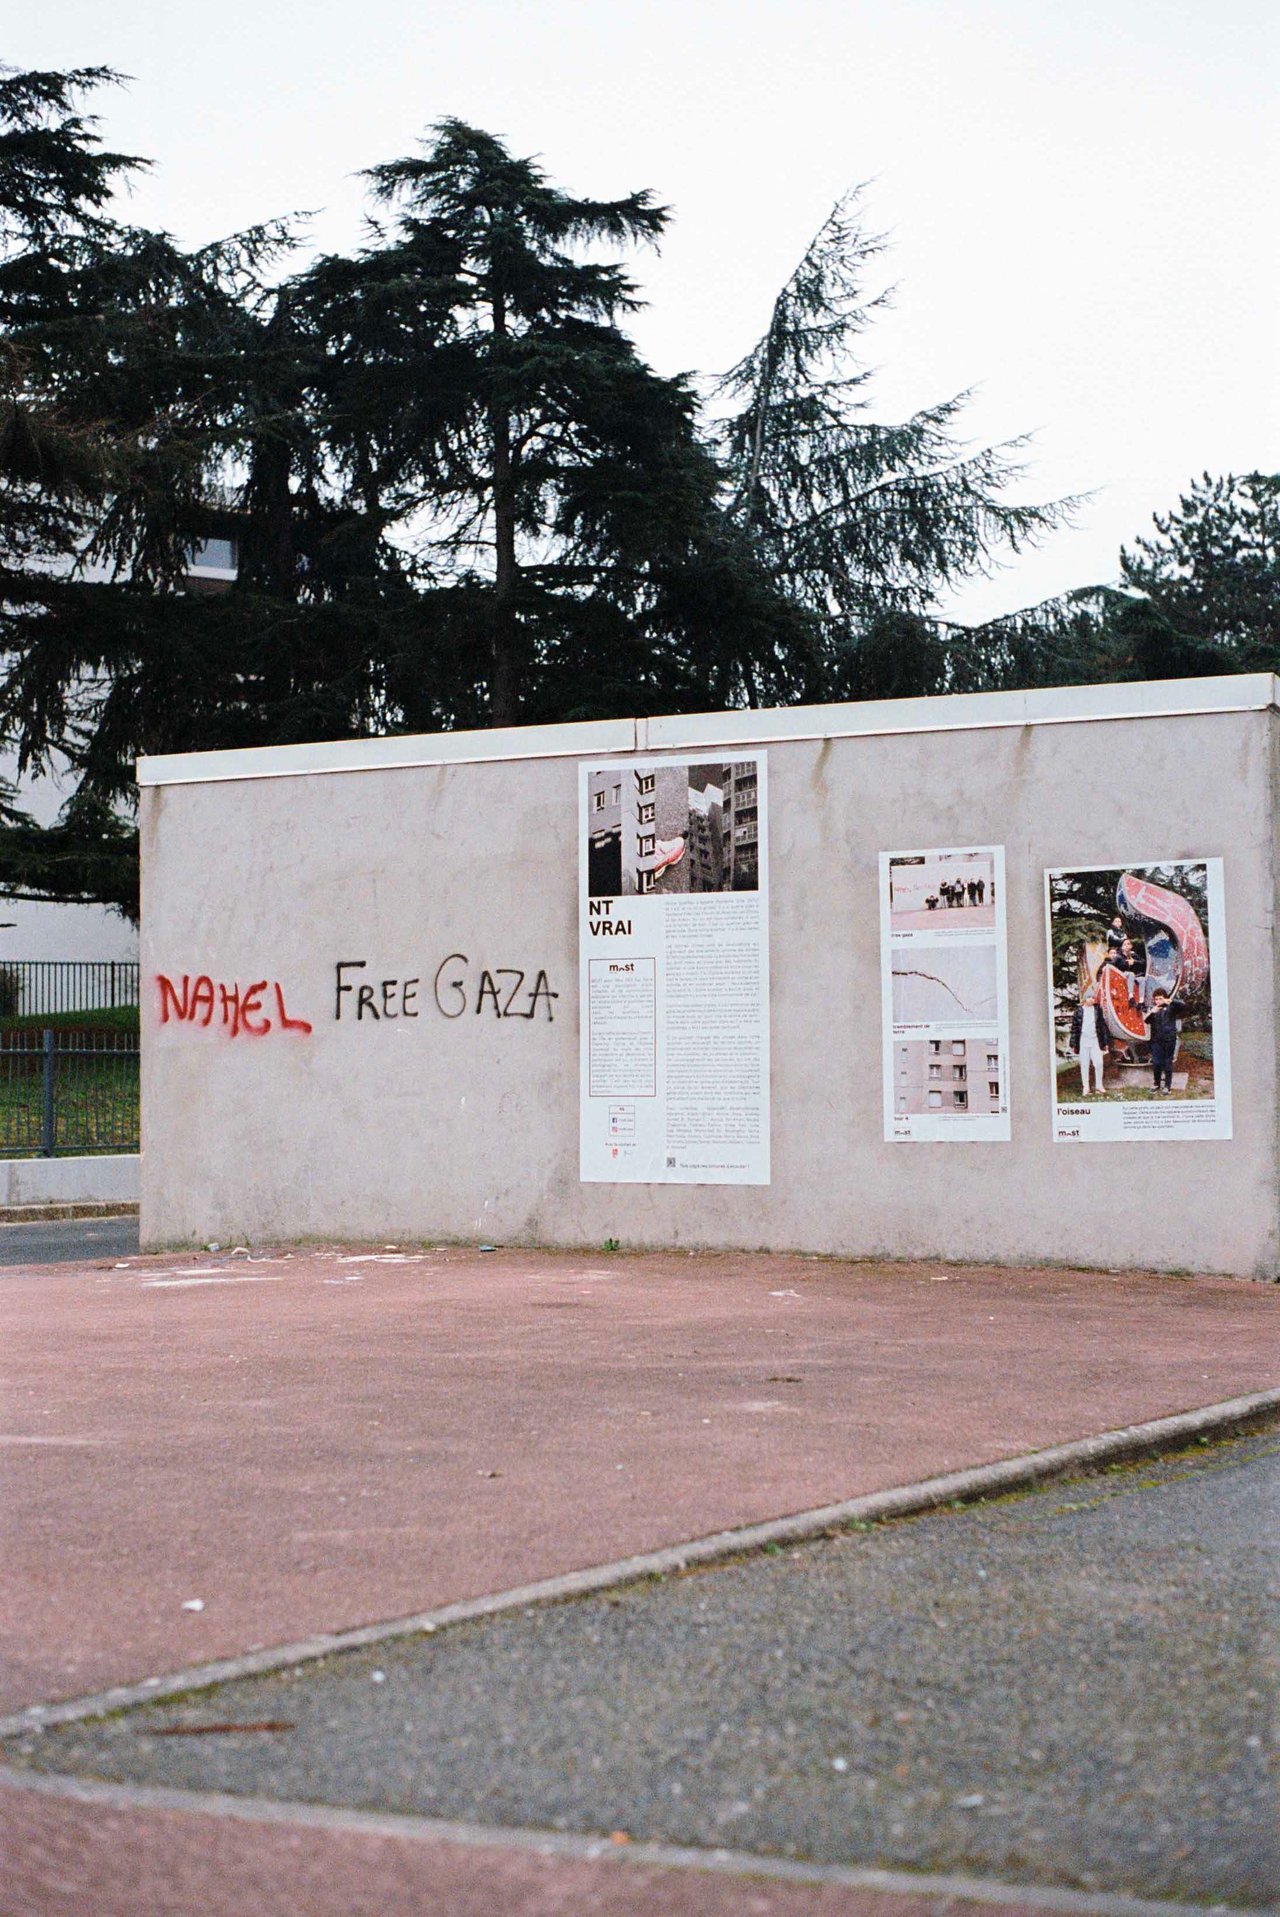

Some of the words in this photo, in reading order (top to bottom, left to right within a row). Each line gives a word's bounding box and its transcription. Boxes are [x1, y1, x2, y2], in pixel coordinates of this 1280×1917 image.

[589, 900, 613, 915] NT
[589, 920, 632, 936] VRAI
[336, 961, 419, 1020] FREE
[434, 954, 558, 1022] GAZA
[157, 974, 312, 1038] NAHEL
[1057, 1107, 1091, 1115] l'oiseau
